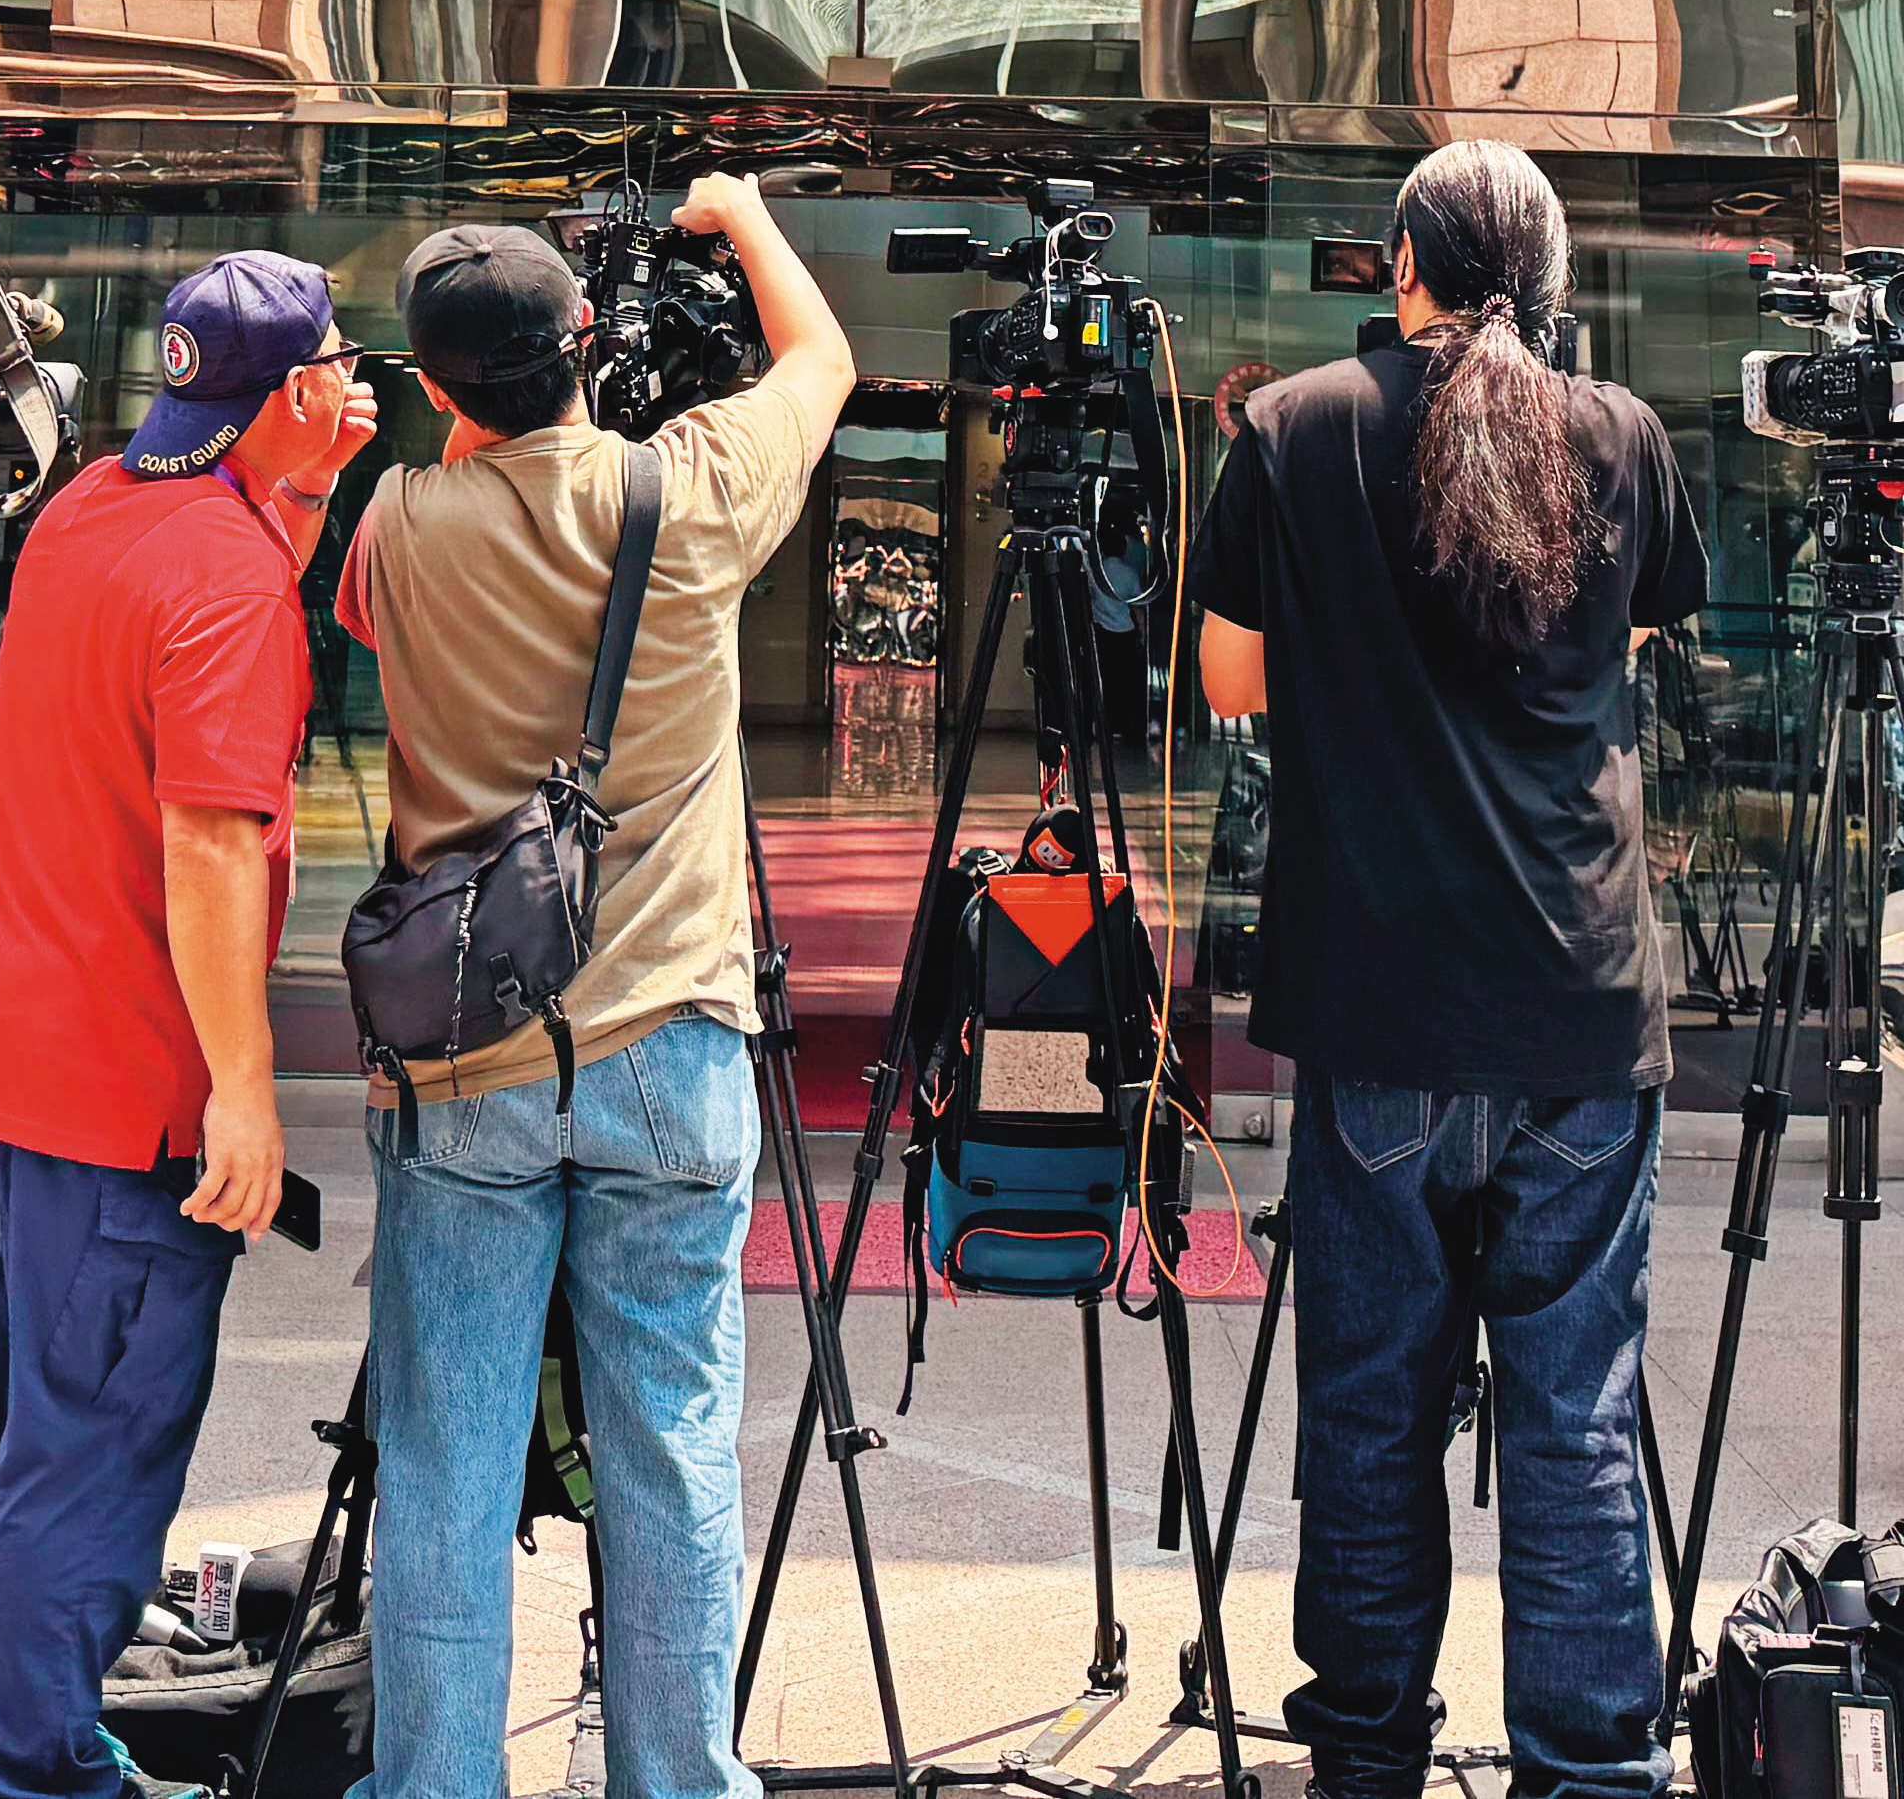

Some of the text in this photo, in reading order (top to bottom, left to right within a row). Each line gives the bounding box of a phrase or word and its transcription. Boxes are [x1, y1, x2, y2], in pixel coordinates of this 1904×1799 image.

[137, 424, 239, 474] COAST GUARD
[212, 1562, 234, 1633] 壹新聞
